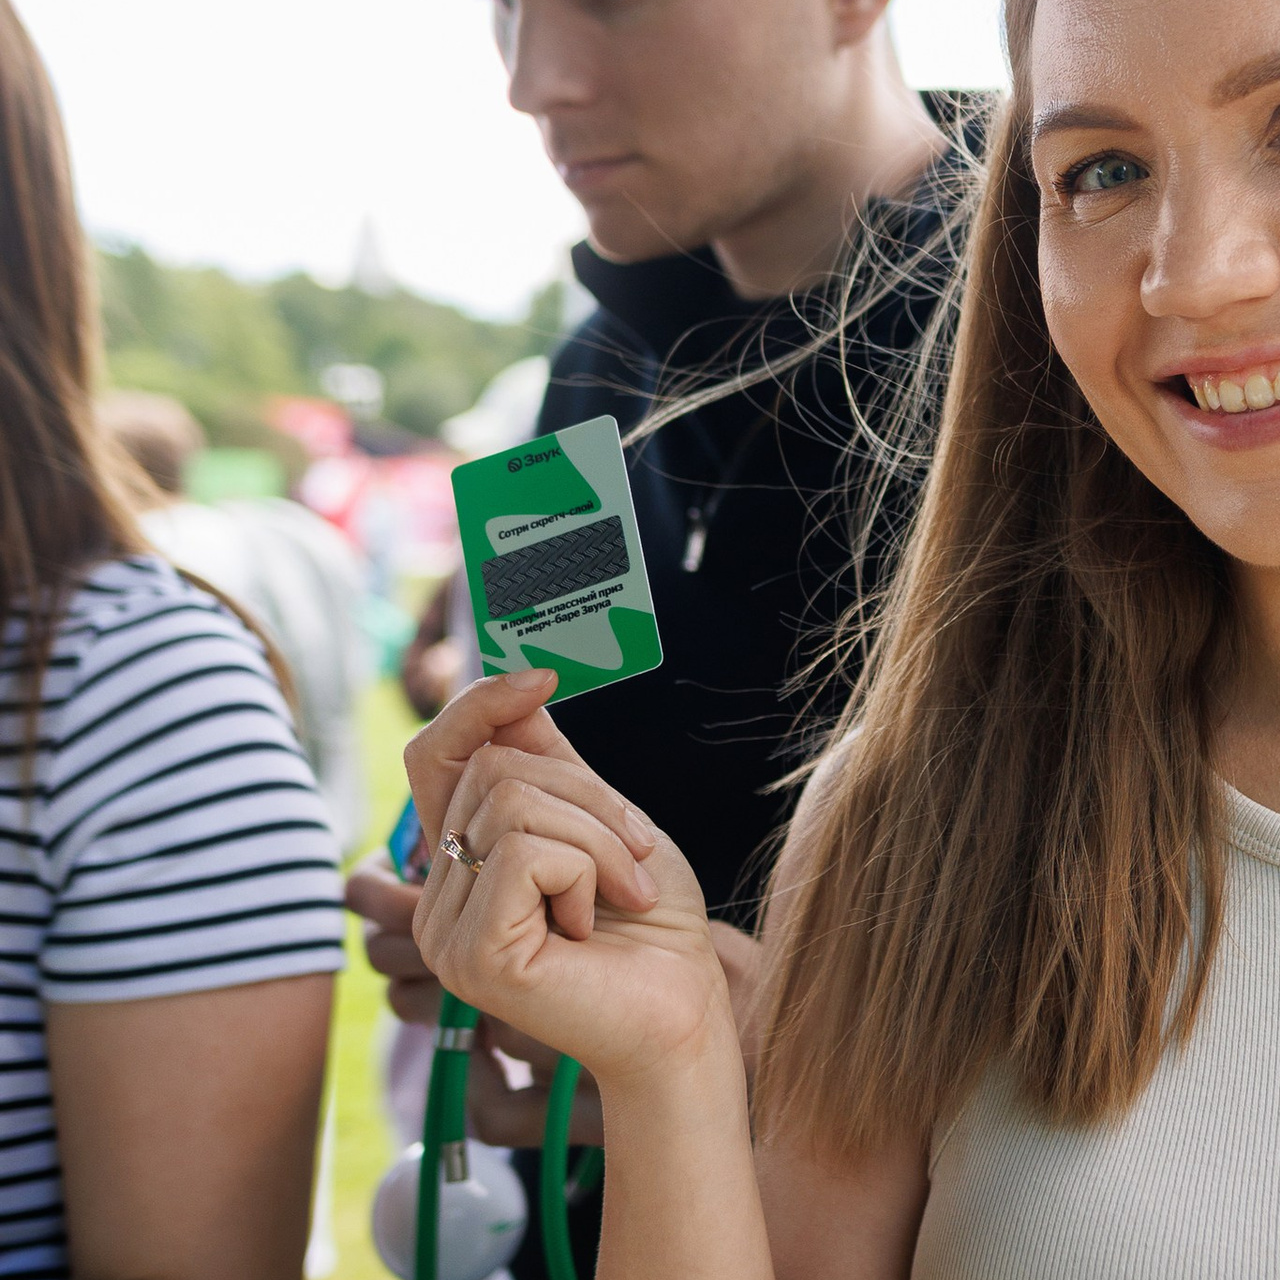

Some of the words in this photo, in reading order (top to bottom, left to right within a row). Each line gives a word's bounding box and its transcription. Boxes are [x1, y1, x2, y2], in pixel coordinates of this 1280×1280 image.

[524, 448, 561, 467] Звук
[498, 524, 529, 540] Сотри
[530, 500, 595, 529] скретч-слой
[501, 622, 509, 631] и
[510, 610, 546, 629] получи
[547, 591, 597, 616] классный
[598, 583, 624, 599] приз
[517, 629, 524, 637] в
[525, 610, 580, 634] мерч-баре
[581, 599, 612, 616] Звука
